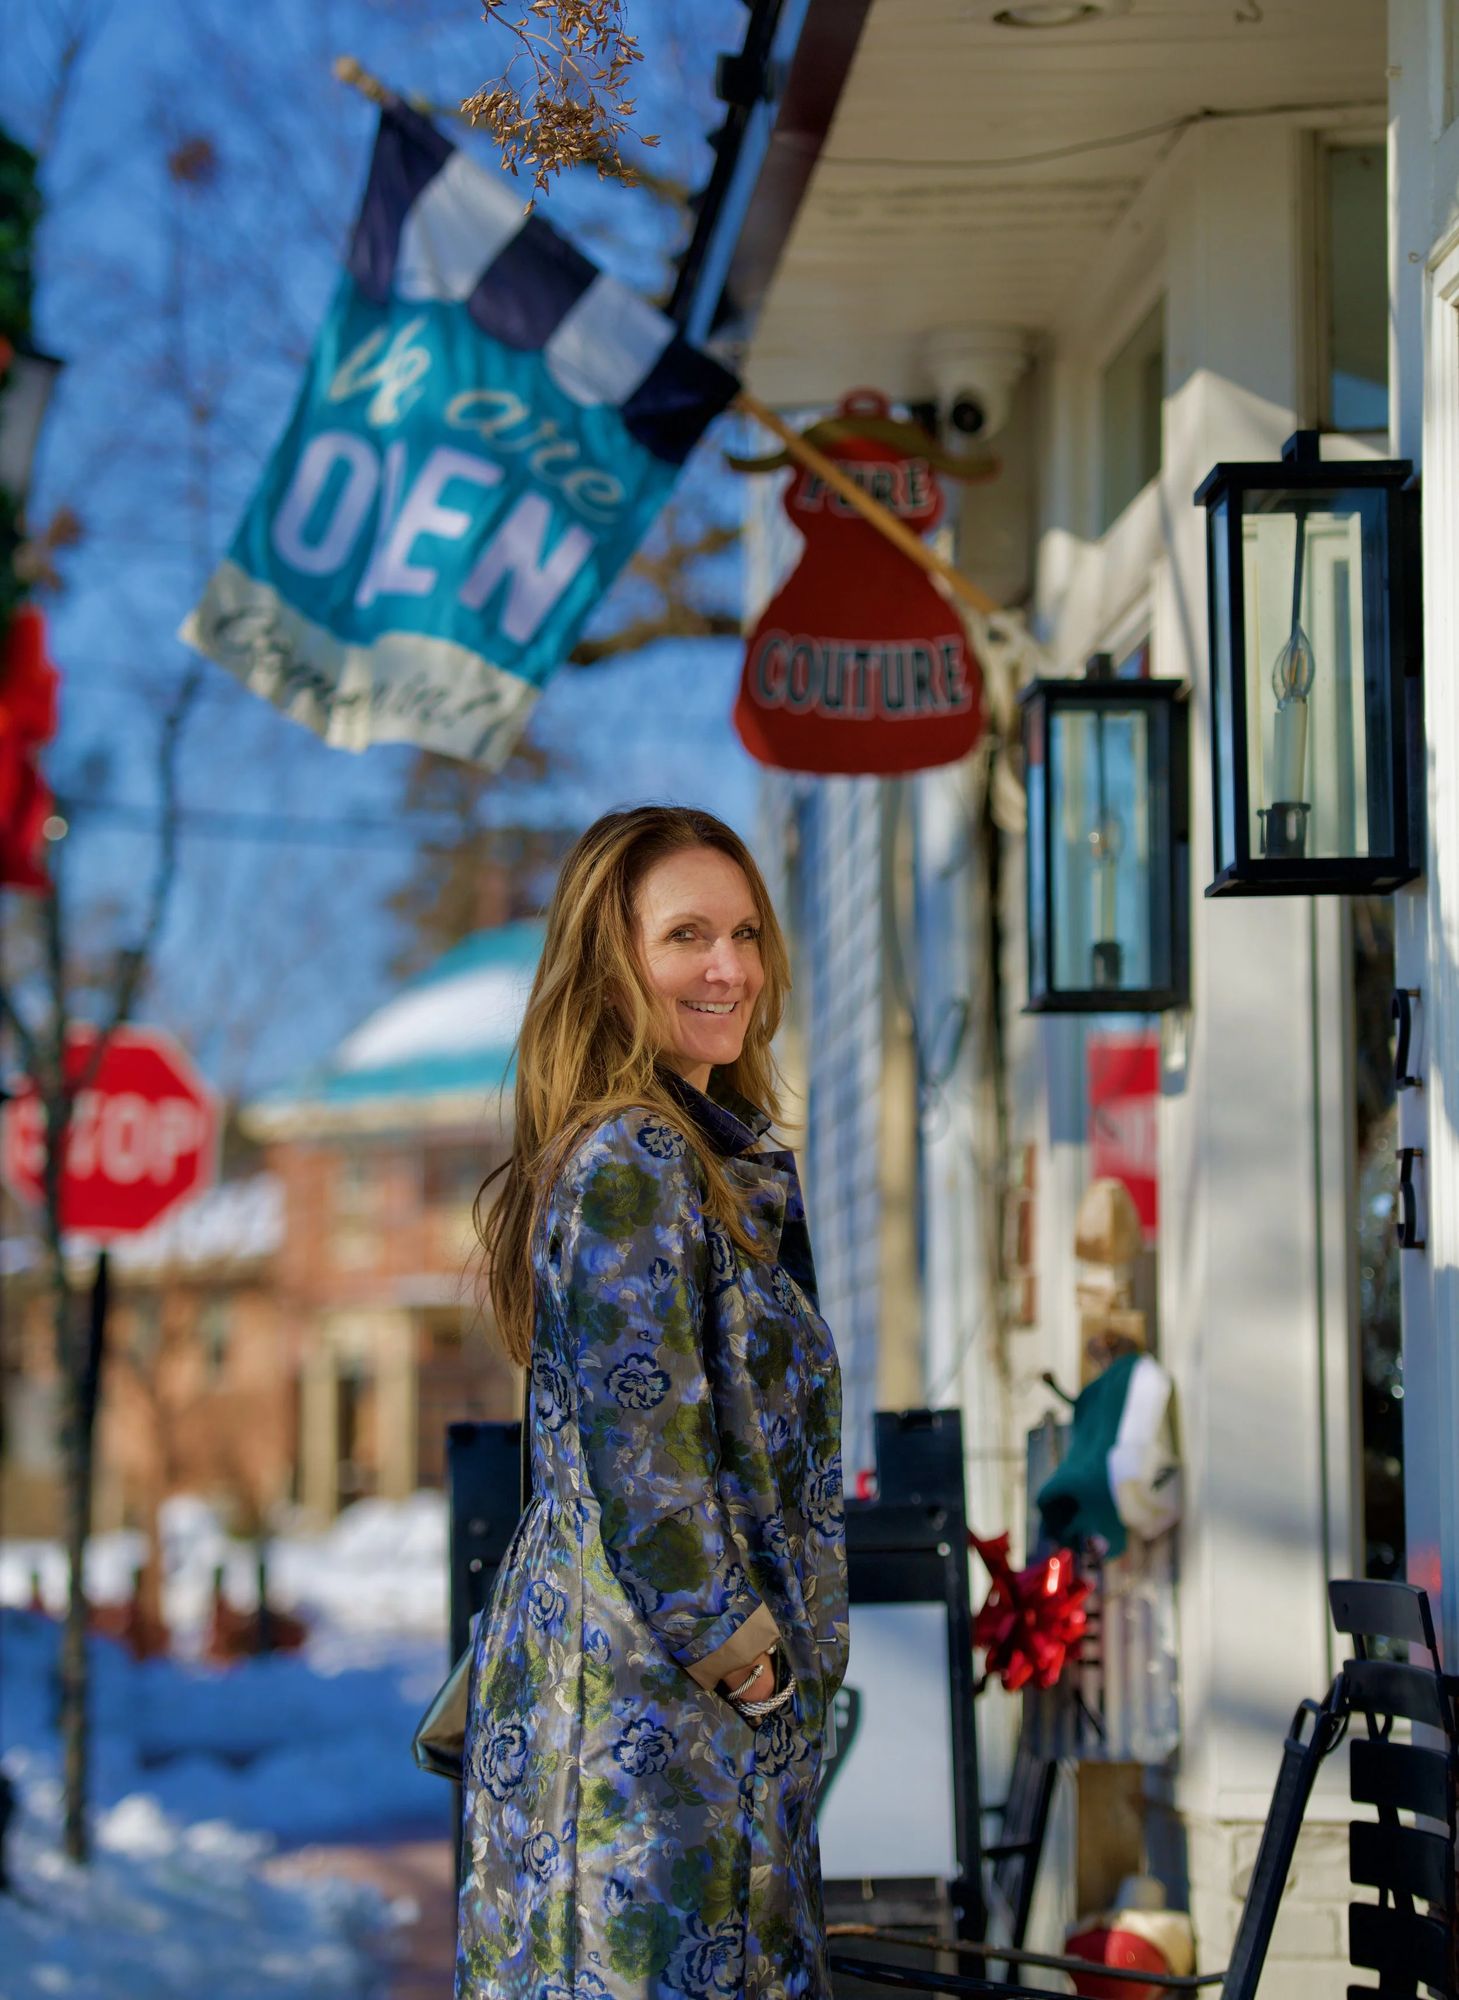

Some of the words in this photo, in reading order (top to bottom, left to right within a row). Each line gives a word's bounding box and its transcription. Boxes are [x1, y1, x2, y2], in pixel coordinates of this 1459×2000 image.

[443, 388, 625, 524] are
[271, 431, 598, 645] OEN
[754, 635, 970, 714] COUTURE
